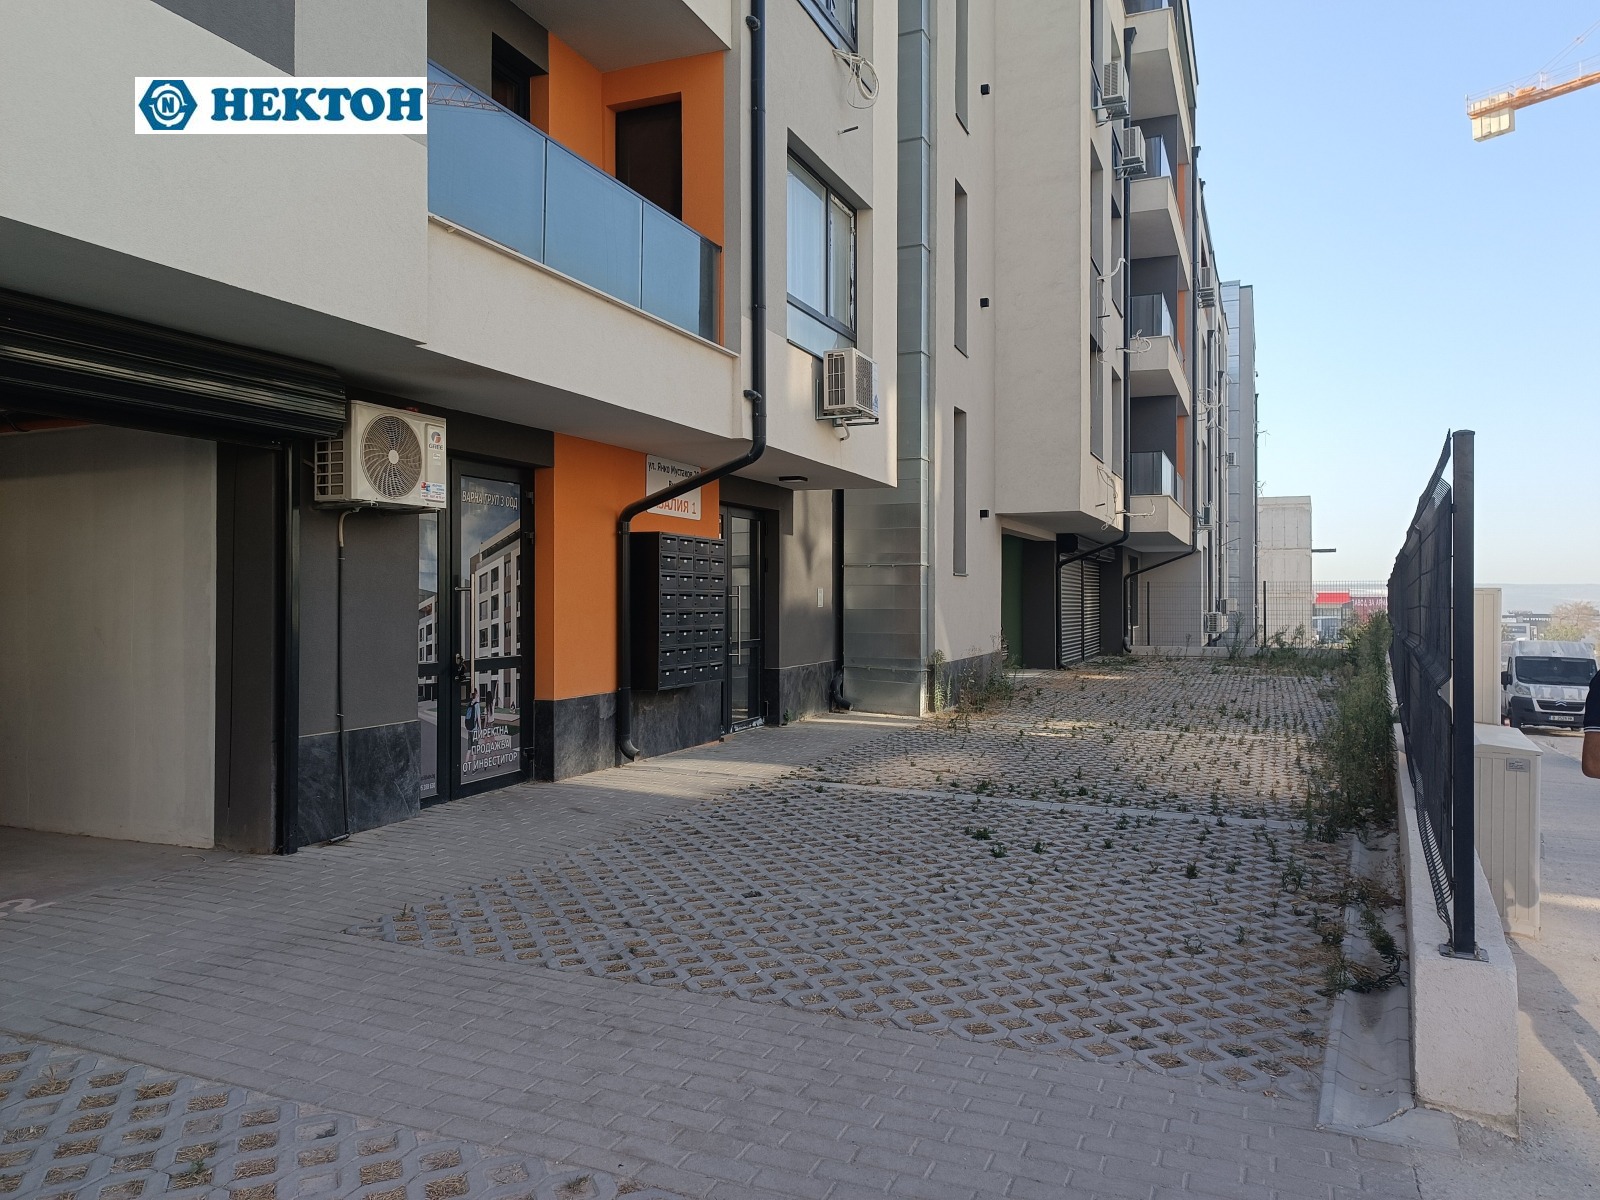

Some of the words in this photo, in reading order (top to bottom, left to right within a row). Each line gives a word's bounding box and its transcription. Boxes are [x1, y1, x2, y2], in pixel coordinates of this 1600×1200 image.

[648, 461, 656, 472] ул.
[462, 490, 483, 505] ВАРНА
[484, 493, 499, 506] ГРУП
[505, 496, 518, 511] ООД
[656, 498, 689, 513] ЗАЛИЯ
[691, 502, 697, 514] 1
[473, 725, 509, 741] ДИРЕКТНА
[471, 740, 509, 756] ПРОДАЖБА
[462, 761, 472, 772] ОТ
[473, 752, 518, 770] ИНВЕСТИТОР
